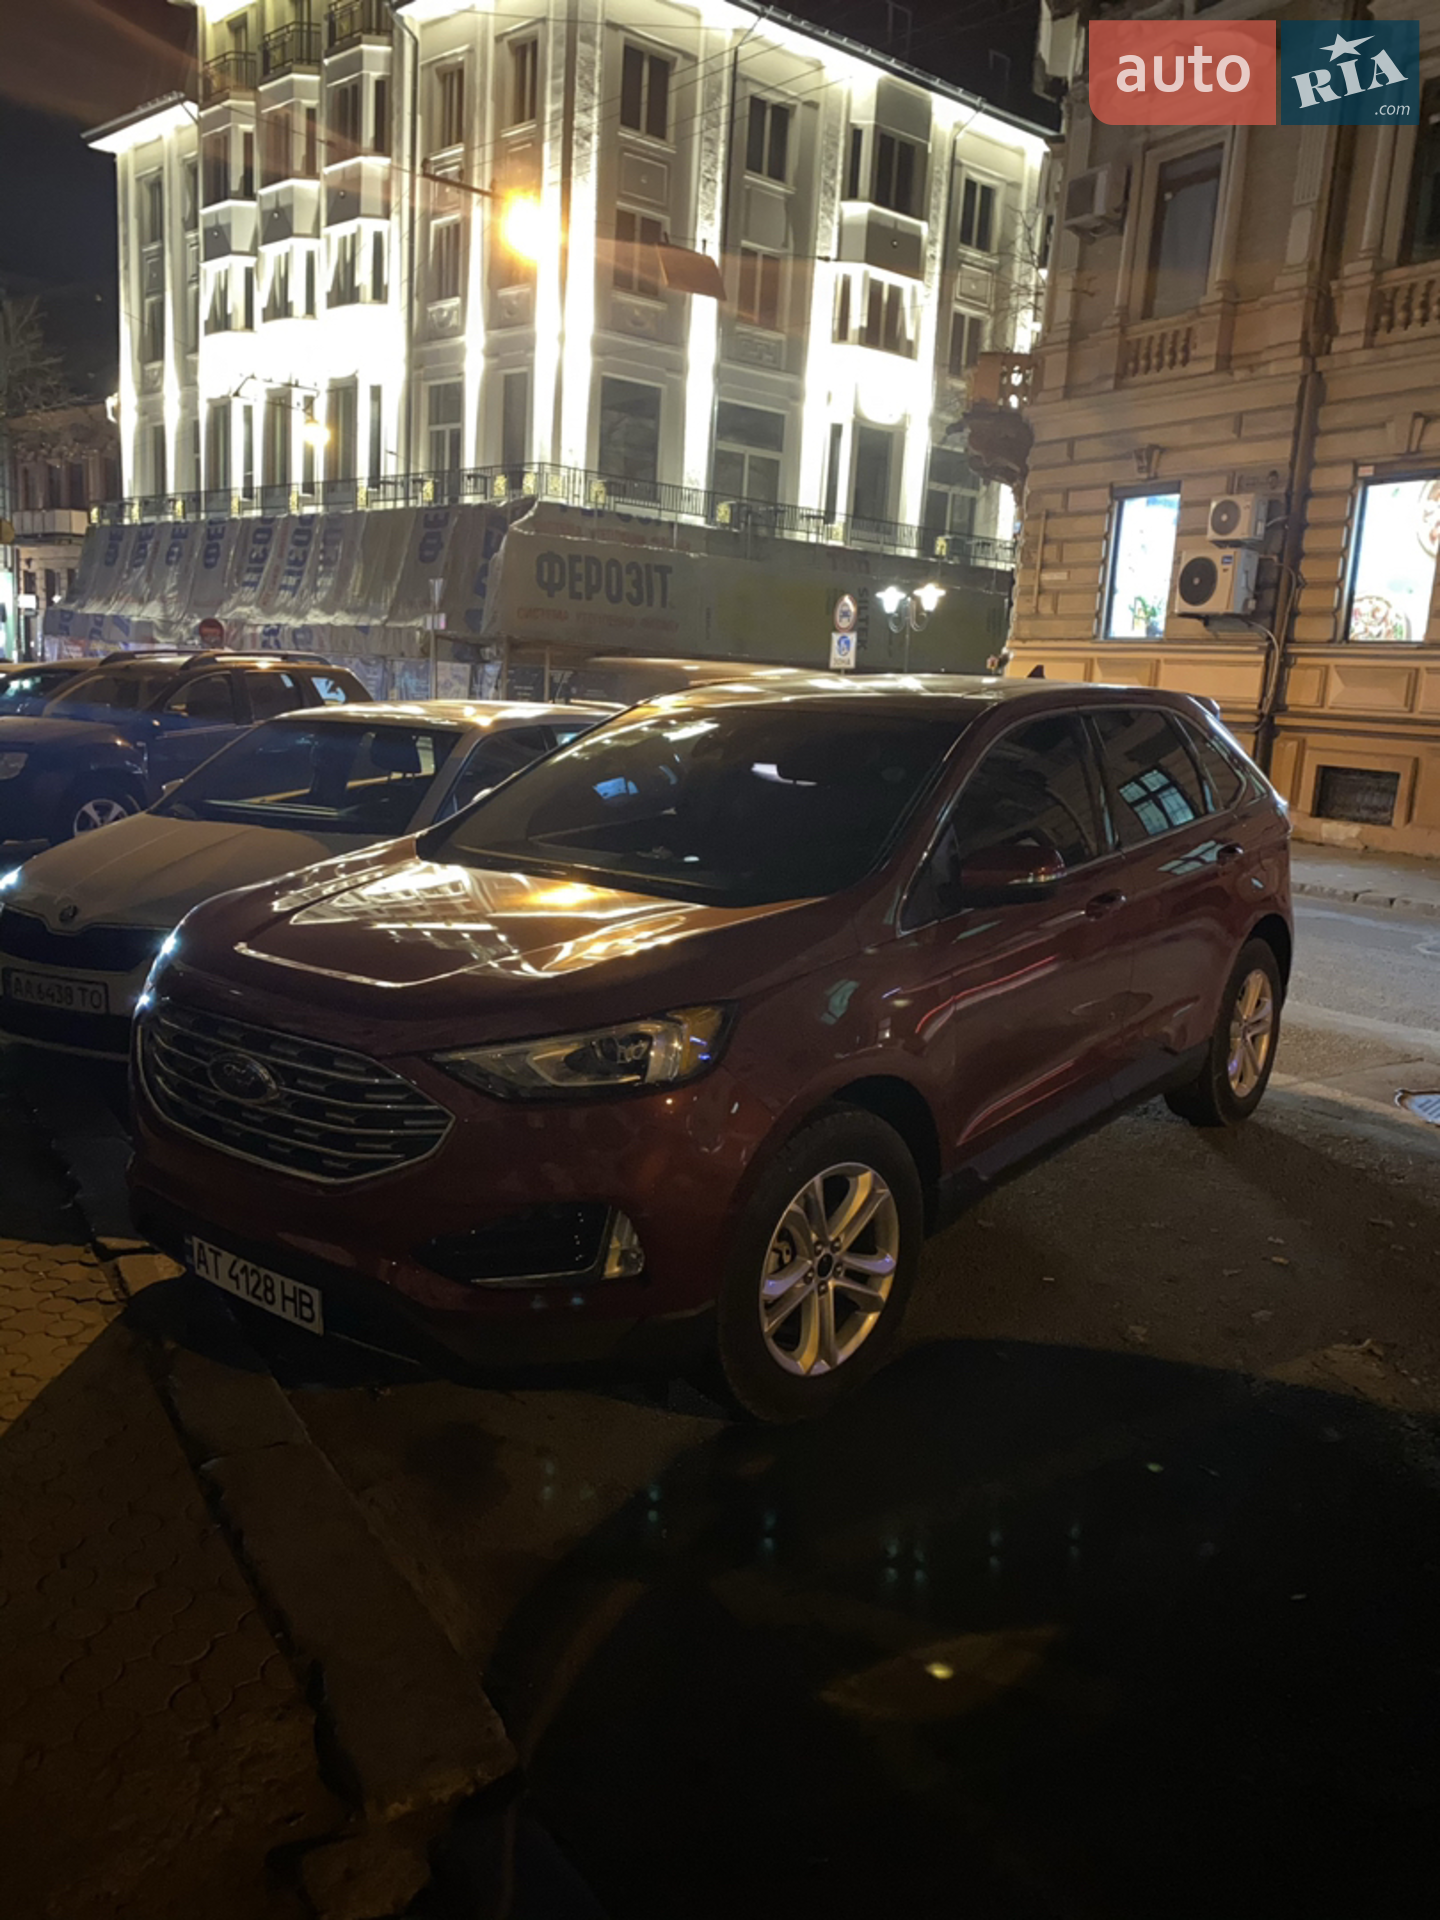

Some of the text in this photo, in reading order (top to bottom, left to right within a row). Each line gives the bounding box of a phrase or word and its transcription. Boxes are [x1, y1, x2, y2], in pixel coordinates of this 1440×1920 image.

[536, 550, 673, 609] ФЕРОЗІТ
[857, 586, 870, 651] SILTEK
[196, 1243, 316, 1324] AT 4128 HB
